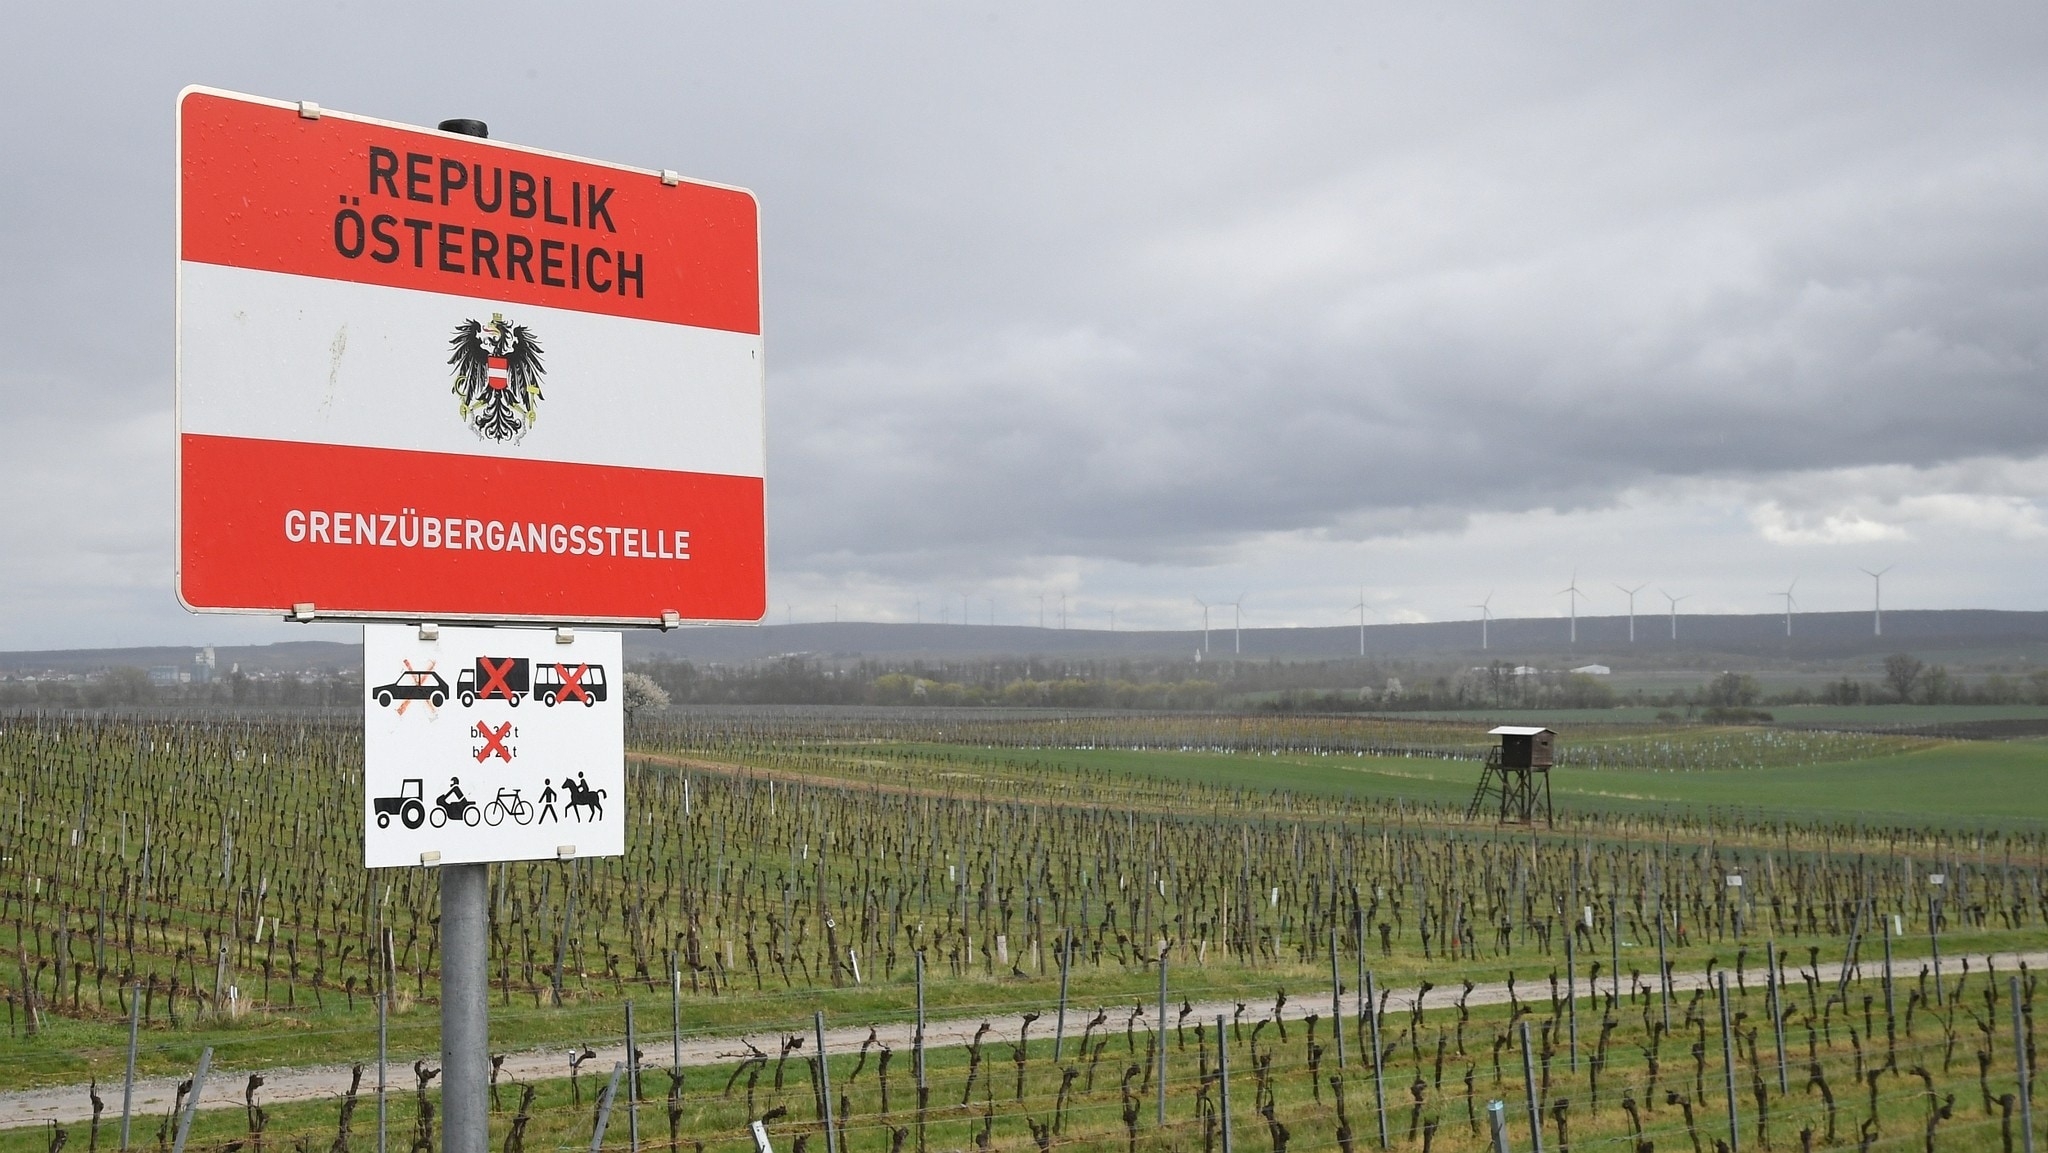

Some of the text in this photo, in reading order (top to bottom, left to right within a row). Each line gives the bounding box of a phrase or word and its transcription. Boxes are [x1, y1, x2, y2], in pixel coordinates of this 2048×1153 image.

[368, 145, 617, 234] REPUBLIK
[333, 194, 645, 300] ÖSTERREICH
[284, 508, 691, 560] GRENZÜBERGANGSSTELLE
[512, 746, 517, 758] t
[514, 726, 519, 738] t
